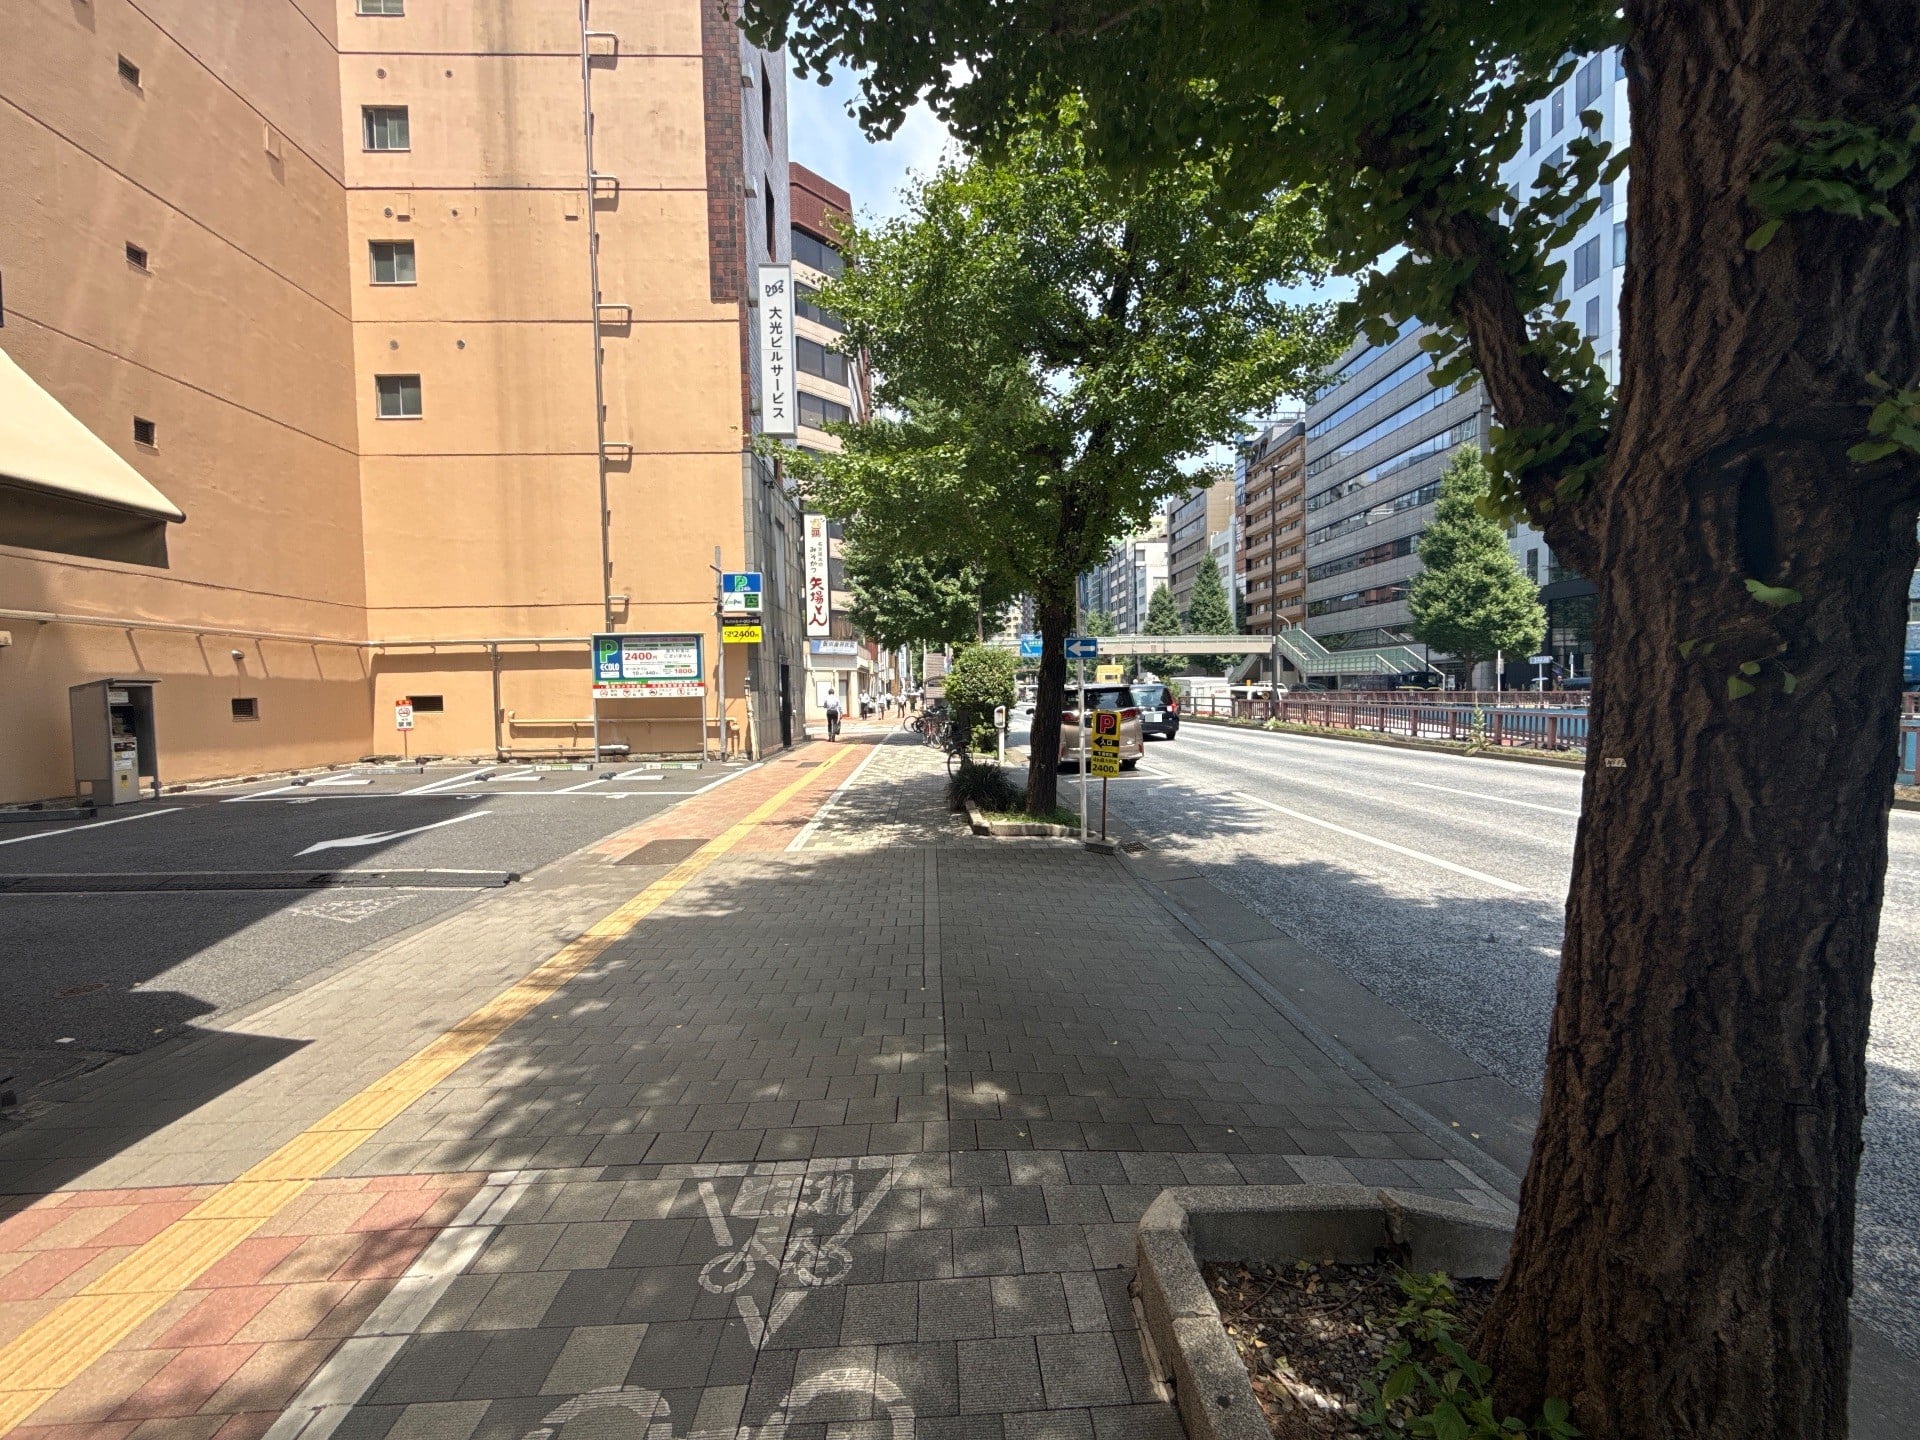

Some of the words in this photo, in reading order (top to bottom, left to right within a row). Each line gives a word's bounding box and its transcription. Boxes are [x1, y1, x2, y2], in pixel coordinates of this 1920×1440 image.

[765, 281, 784, 296] DBS
[769, 306, 785, 418] 大光ビルサービス
[810, 546, 818, 573] みそかつ
[734, 575, 747, 592] P
[808, 576, 828, 626] 矢場とん
[600, 639, 618, 663] P
[624, 652, 658, 661] 2400円
[1099, 714, 1115, 734] P
